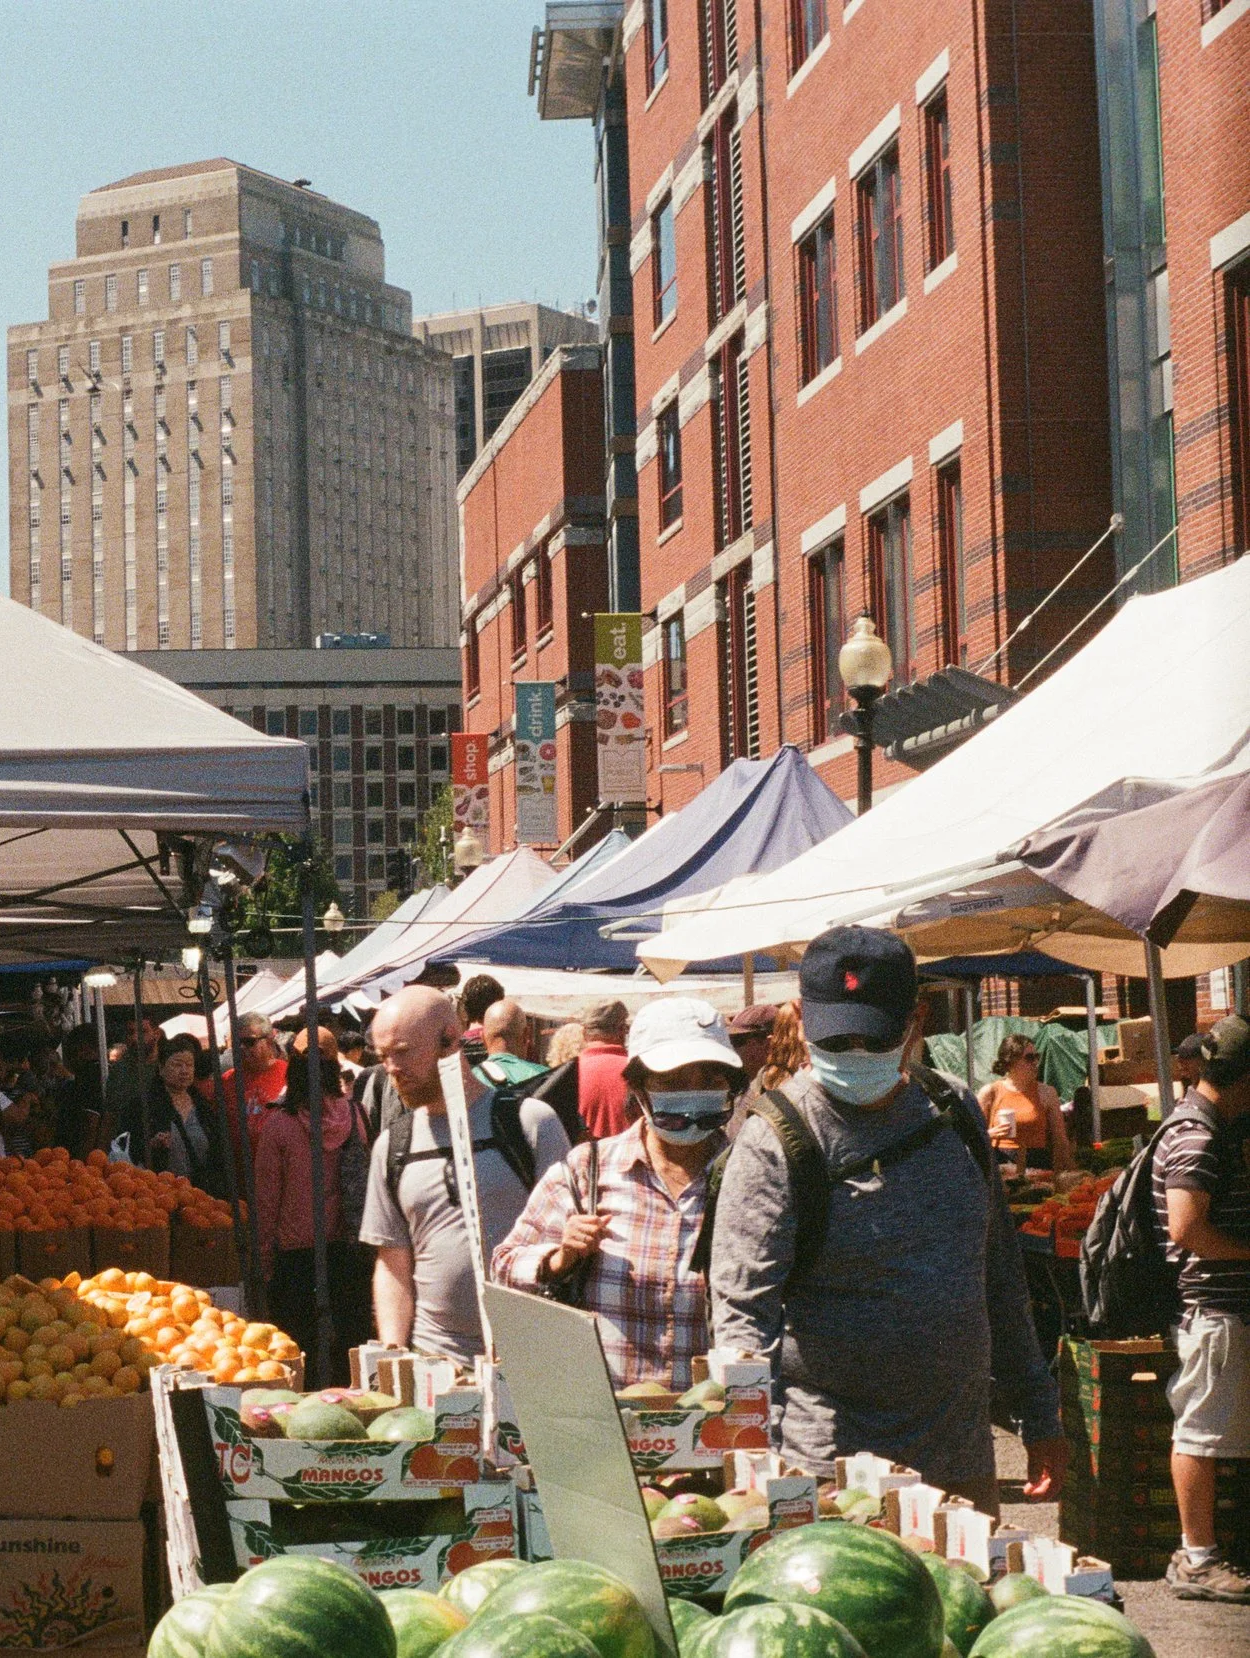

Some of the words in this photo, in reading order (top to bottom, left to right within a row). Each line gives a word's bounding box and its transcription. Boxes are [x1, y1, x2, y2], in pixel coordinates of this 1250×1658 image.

[609, 621, 628, 660] eat.
[529, 687, 543, 737] drink.
[463, 739, 479, 782] shop.
[628, 1437, 677, 1452] NGOS
[301, 1467, 384, 1483] MANGOS
[660, 1559, 725, 1579] ANGOS
